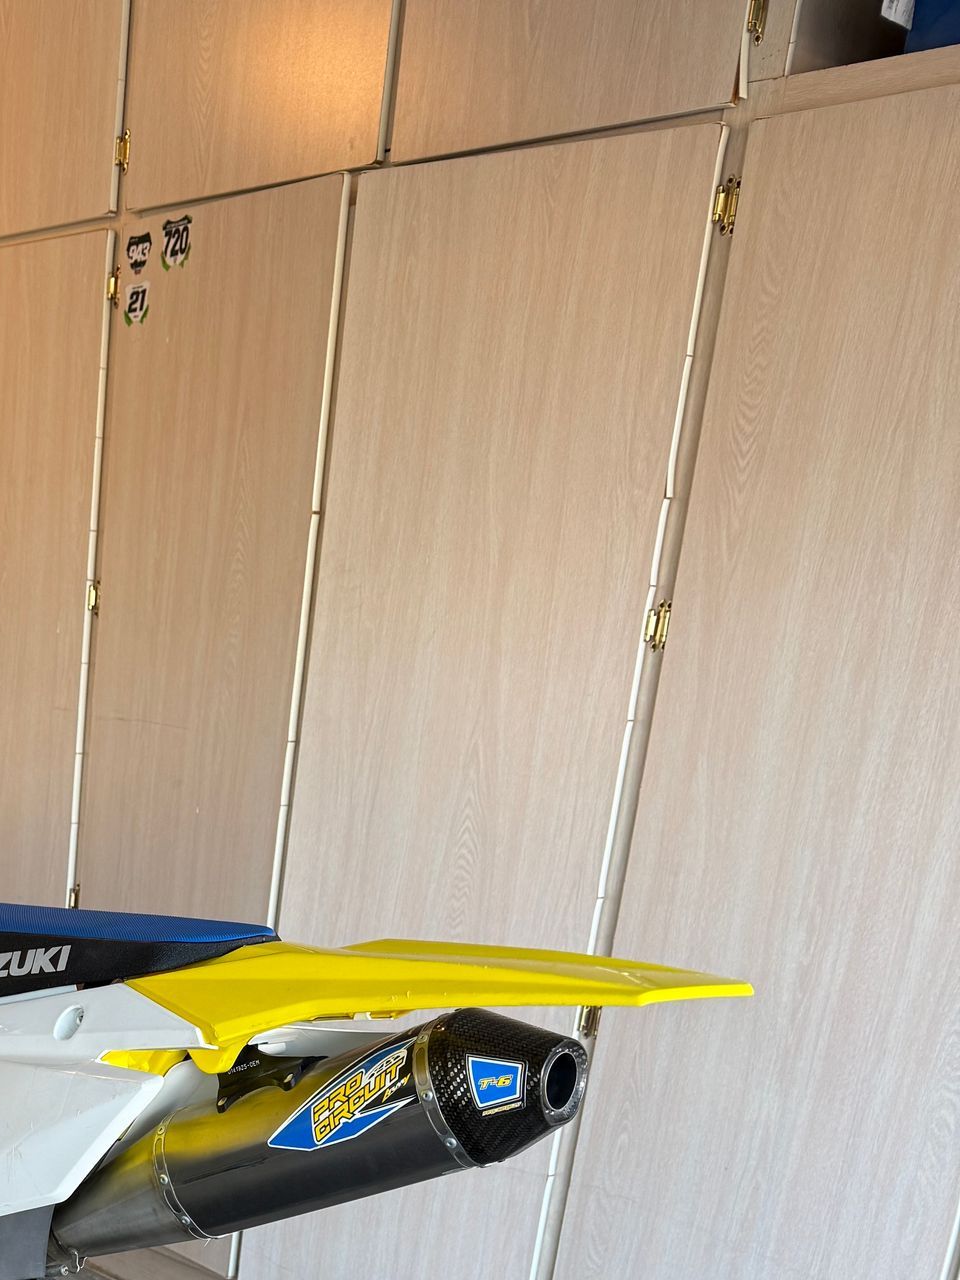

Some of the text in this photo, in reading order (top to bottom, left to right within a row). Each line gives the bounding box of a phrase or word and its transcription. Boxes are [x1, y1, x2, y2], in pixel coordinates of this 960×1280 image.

[128, 241, 150, 262] 943
[164, 224, 190, 258] 720
[127, 288, 147, 314] 21
[313, 1071, 363, 1124] PRO
[478, 1074, 514, 1091] T-6
[314, 1056, 404, 1142] CIRCUIT
